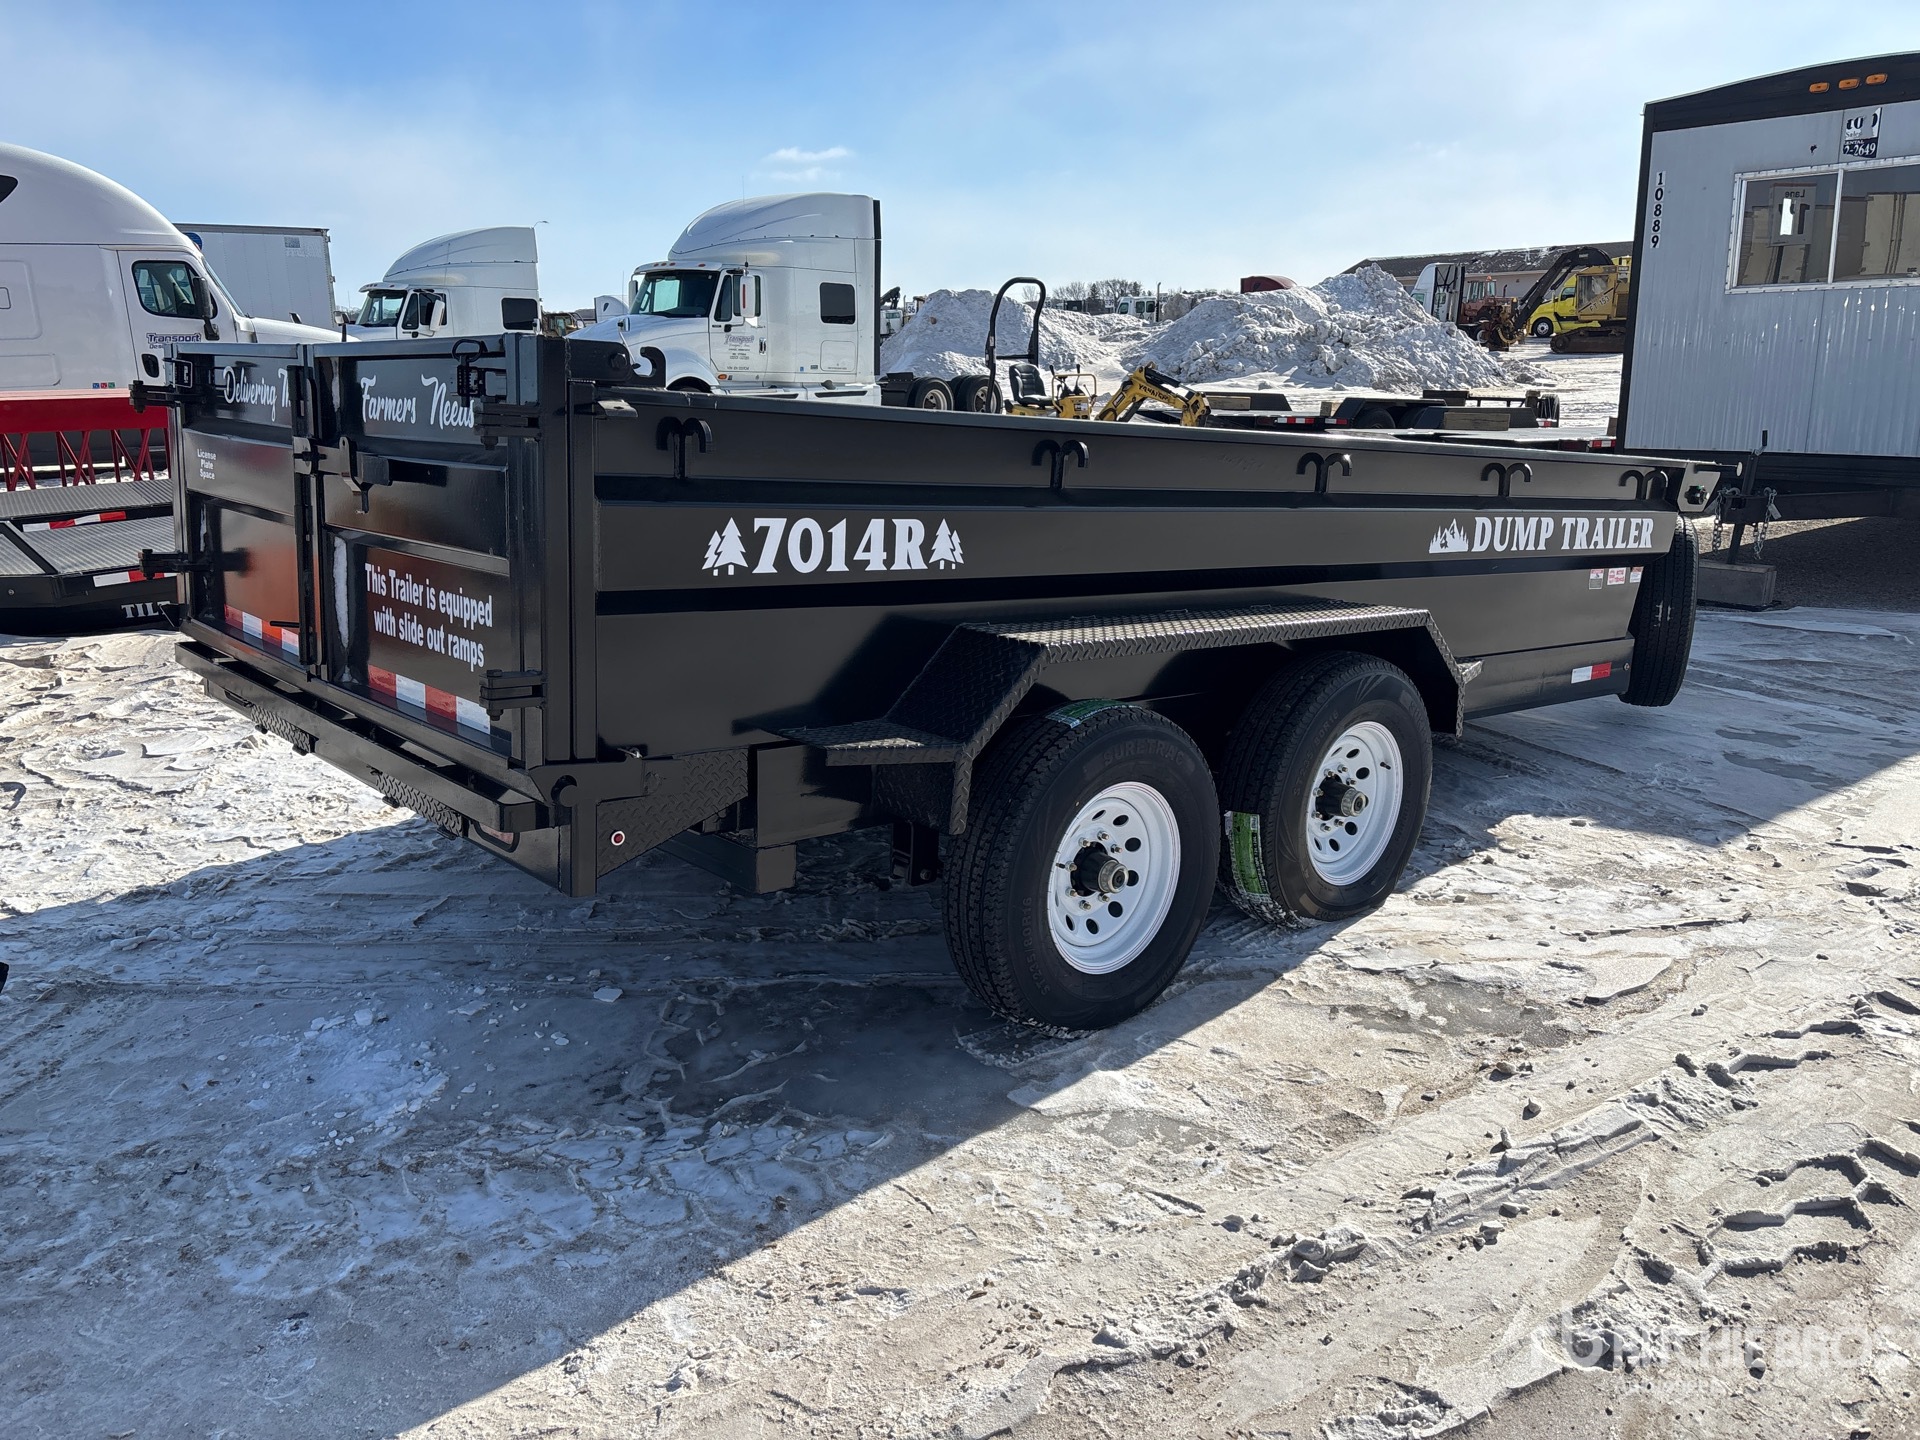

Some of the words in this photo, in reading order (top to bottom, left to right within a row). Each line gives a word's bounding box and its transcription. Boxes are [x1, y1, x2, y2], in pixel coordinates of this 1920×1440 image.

[1651, 172, 1664, 248] 10889
[146, 333, 201, 344] Transport
[223, 366, 278, 422] Delivering
[360, 375, 417, 424] Farmers
[197, 448, 217, 461] License
[199, 468, 216, 480] Space
[200, 459, 214, 470] Plate
[752, 517, 929, 574] 7014R
[1471, 516, 1555, 552] DUMP
[1561, 517, 1654, 550] TRAILER
[365, 563, 387, 596] This
[389, 568, 424, 607] Trailer
[426, 578, 436, 611] is
[439, 587, 493, 631] equipped
[374, 605, 396, 637] with
[398, 612, 424, 647] slide
[427, 624, 445, 655] out
[448, 633, 485, 672] ramps
